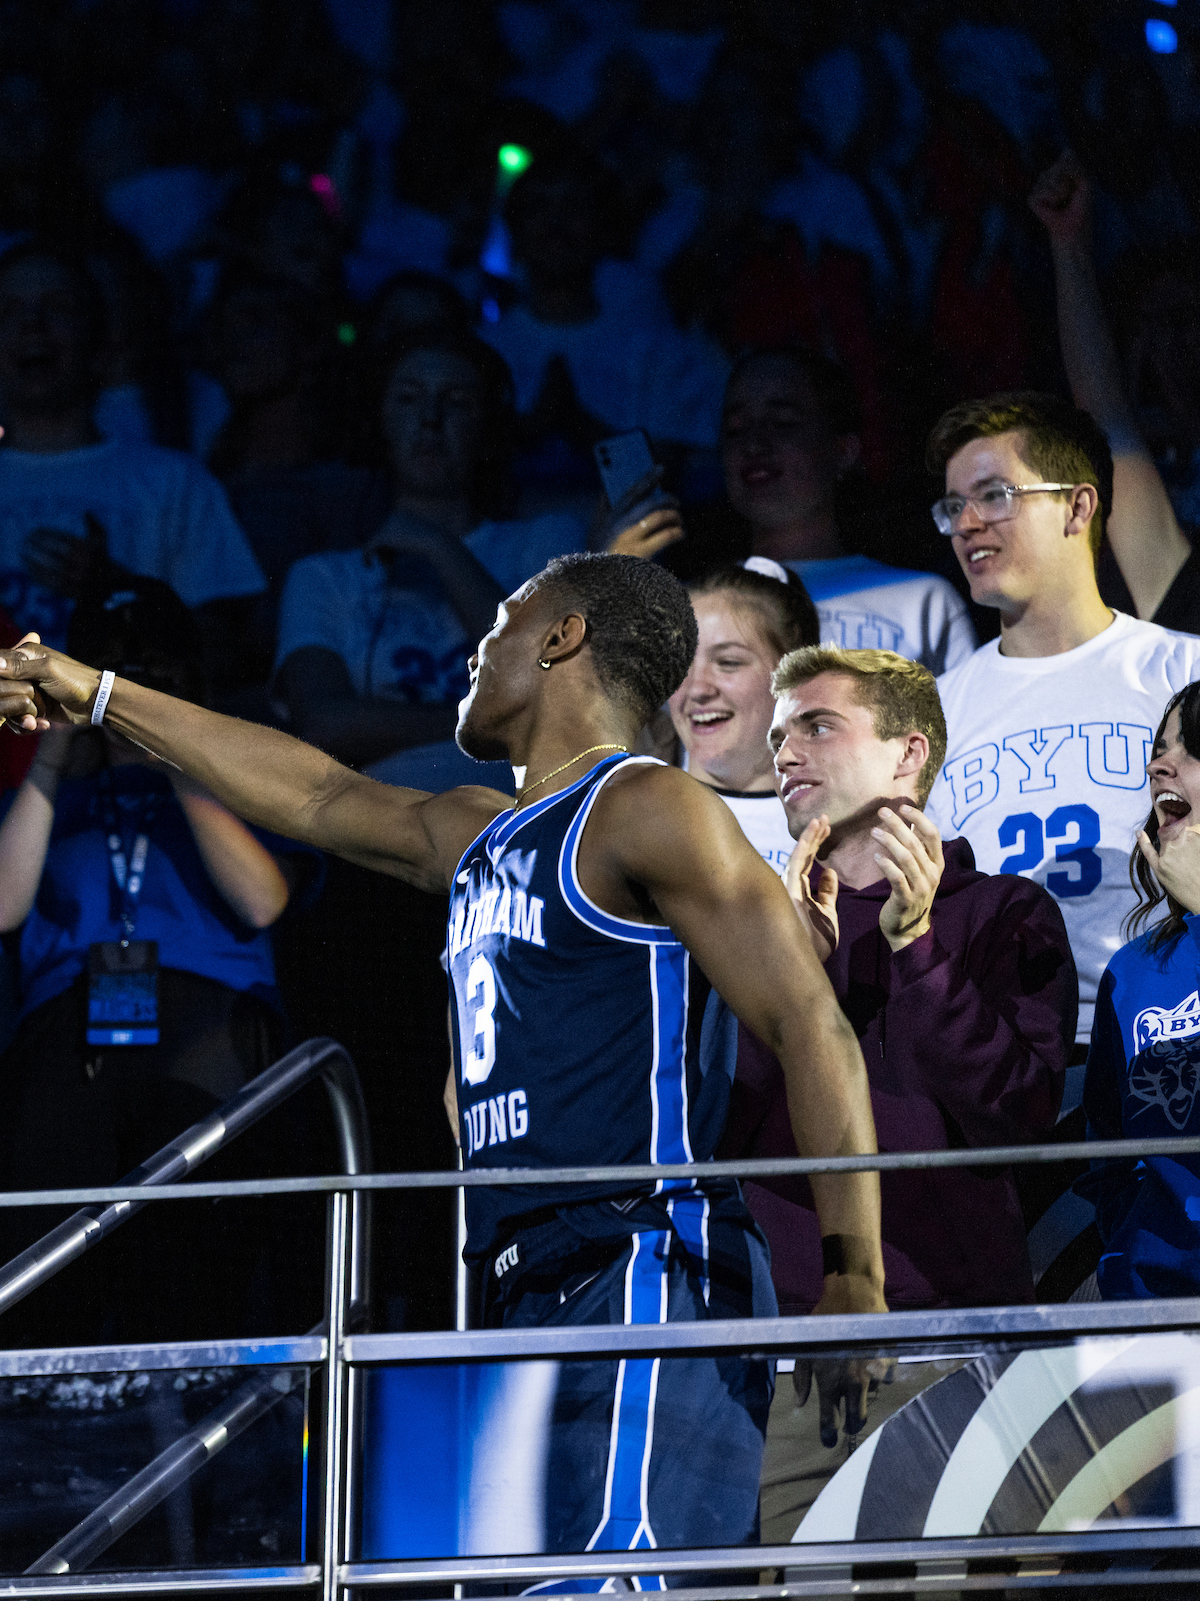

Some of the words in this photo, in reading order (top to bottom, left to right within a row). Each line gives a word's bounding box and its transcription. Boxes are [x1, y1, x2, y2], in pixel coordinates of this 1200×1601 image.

[943, 721, 1153, 831] BYU
[997, 803, 1102, 898] 23
[464, 953, 498, 1087] 3
[495, 1243, 520, 1278] BYU
